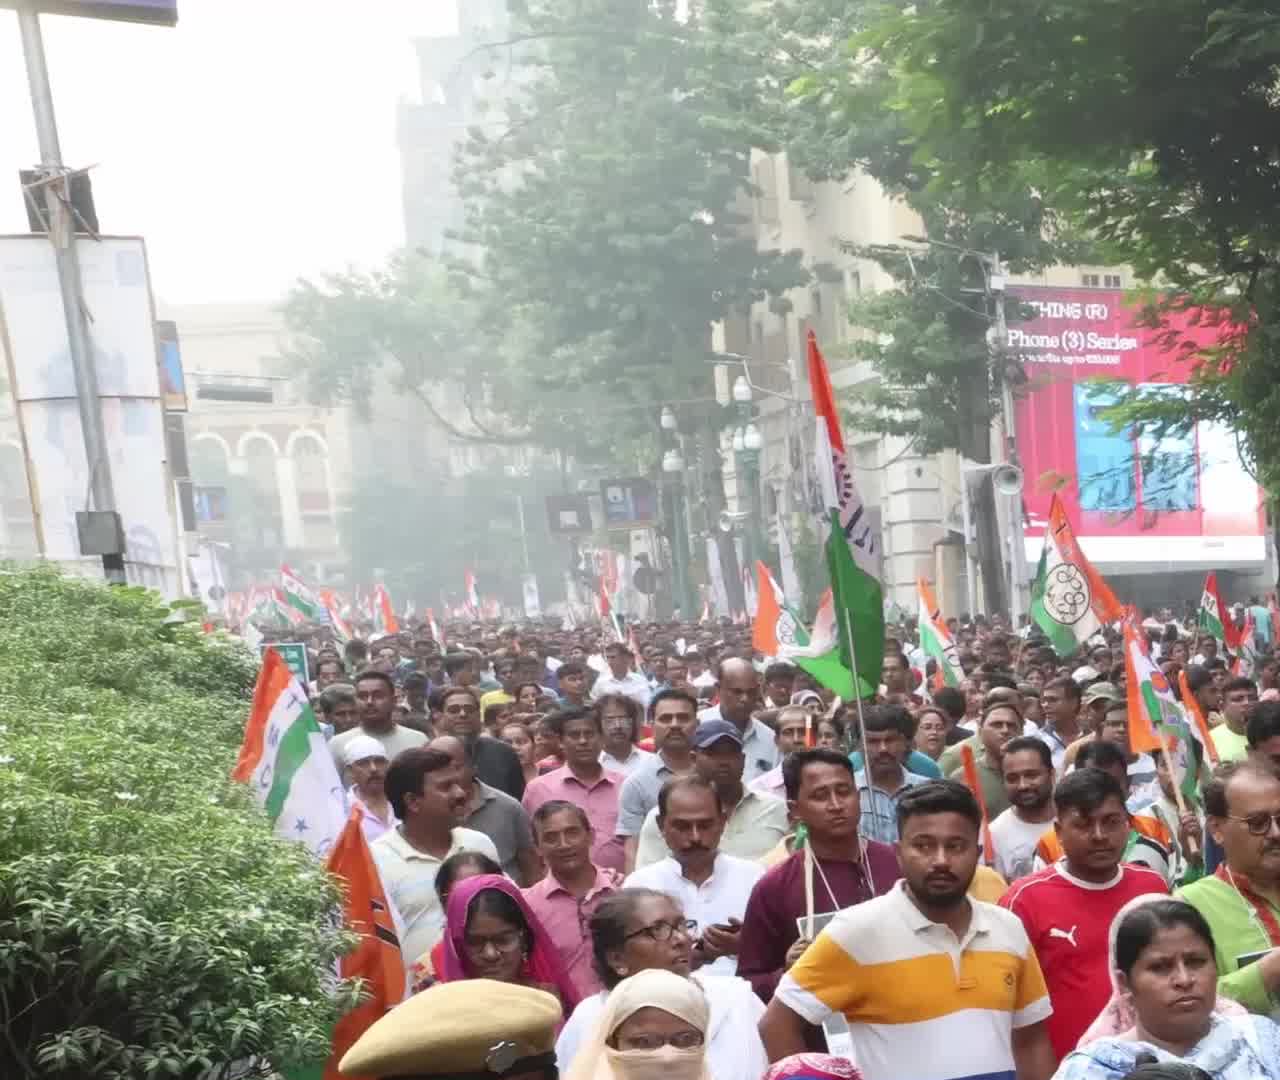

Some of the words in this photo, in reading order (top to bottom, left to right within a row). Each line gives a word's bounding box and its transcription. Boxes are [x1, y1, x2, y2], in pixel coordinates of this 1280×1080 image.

[1007, 329, 1060, 348] Phone
[1062, 330, 1085, 352] (3)
[1087, 332, 1137, 350] Series
